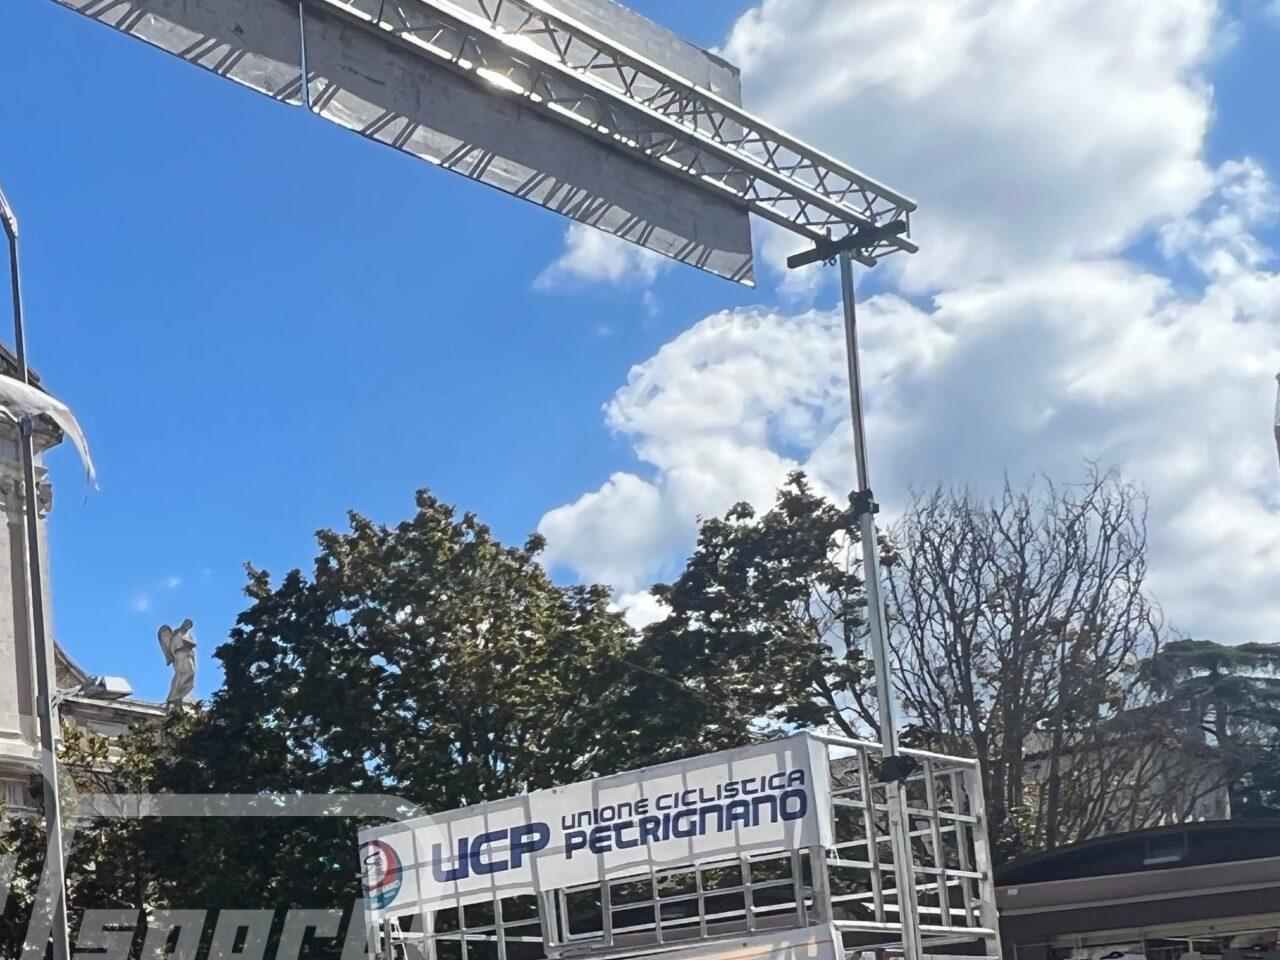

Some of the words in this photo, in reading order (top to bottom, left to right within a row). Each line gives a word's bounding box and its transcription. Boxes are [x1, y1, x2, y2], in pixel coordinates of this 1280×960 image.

[562, 798, 648, 830] UNIONE
[656, 769, 805, 811] CICLISTICA
[565, 788, 808, 860] PETRIGNANO
[432, 822, 550, 883] UCP
